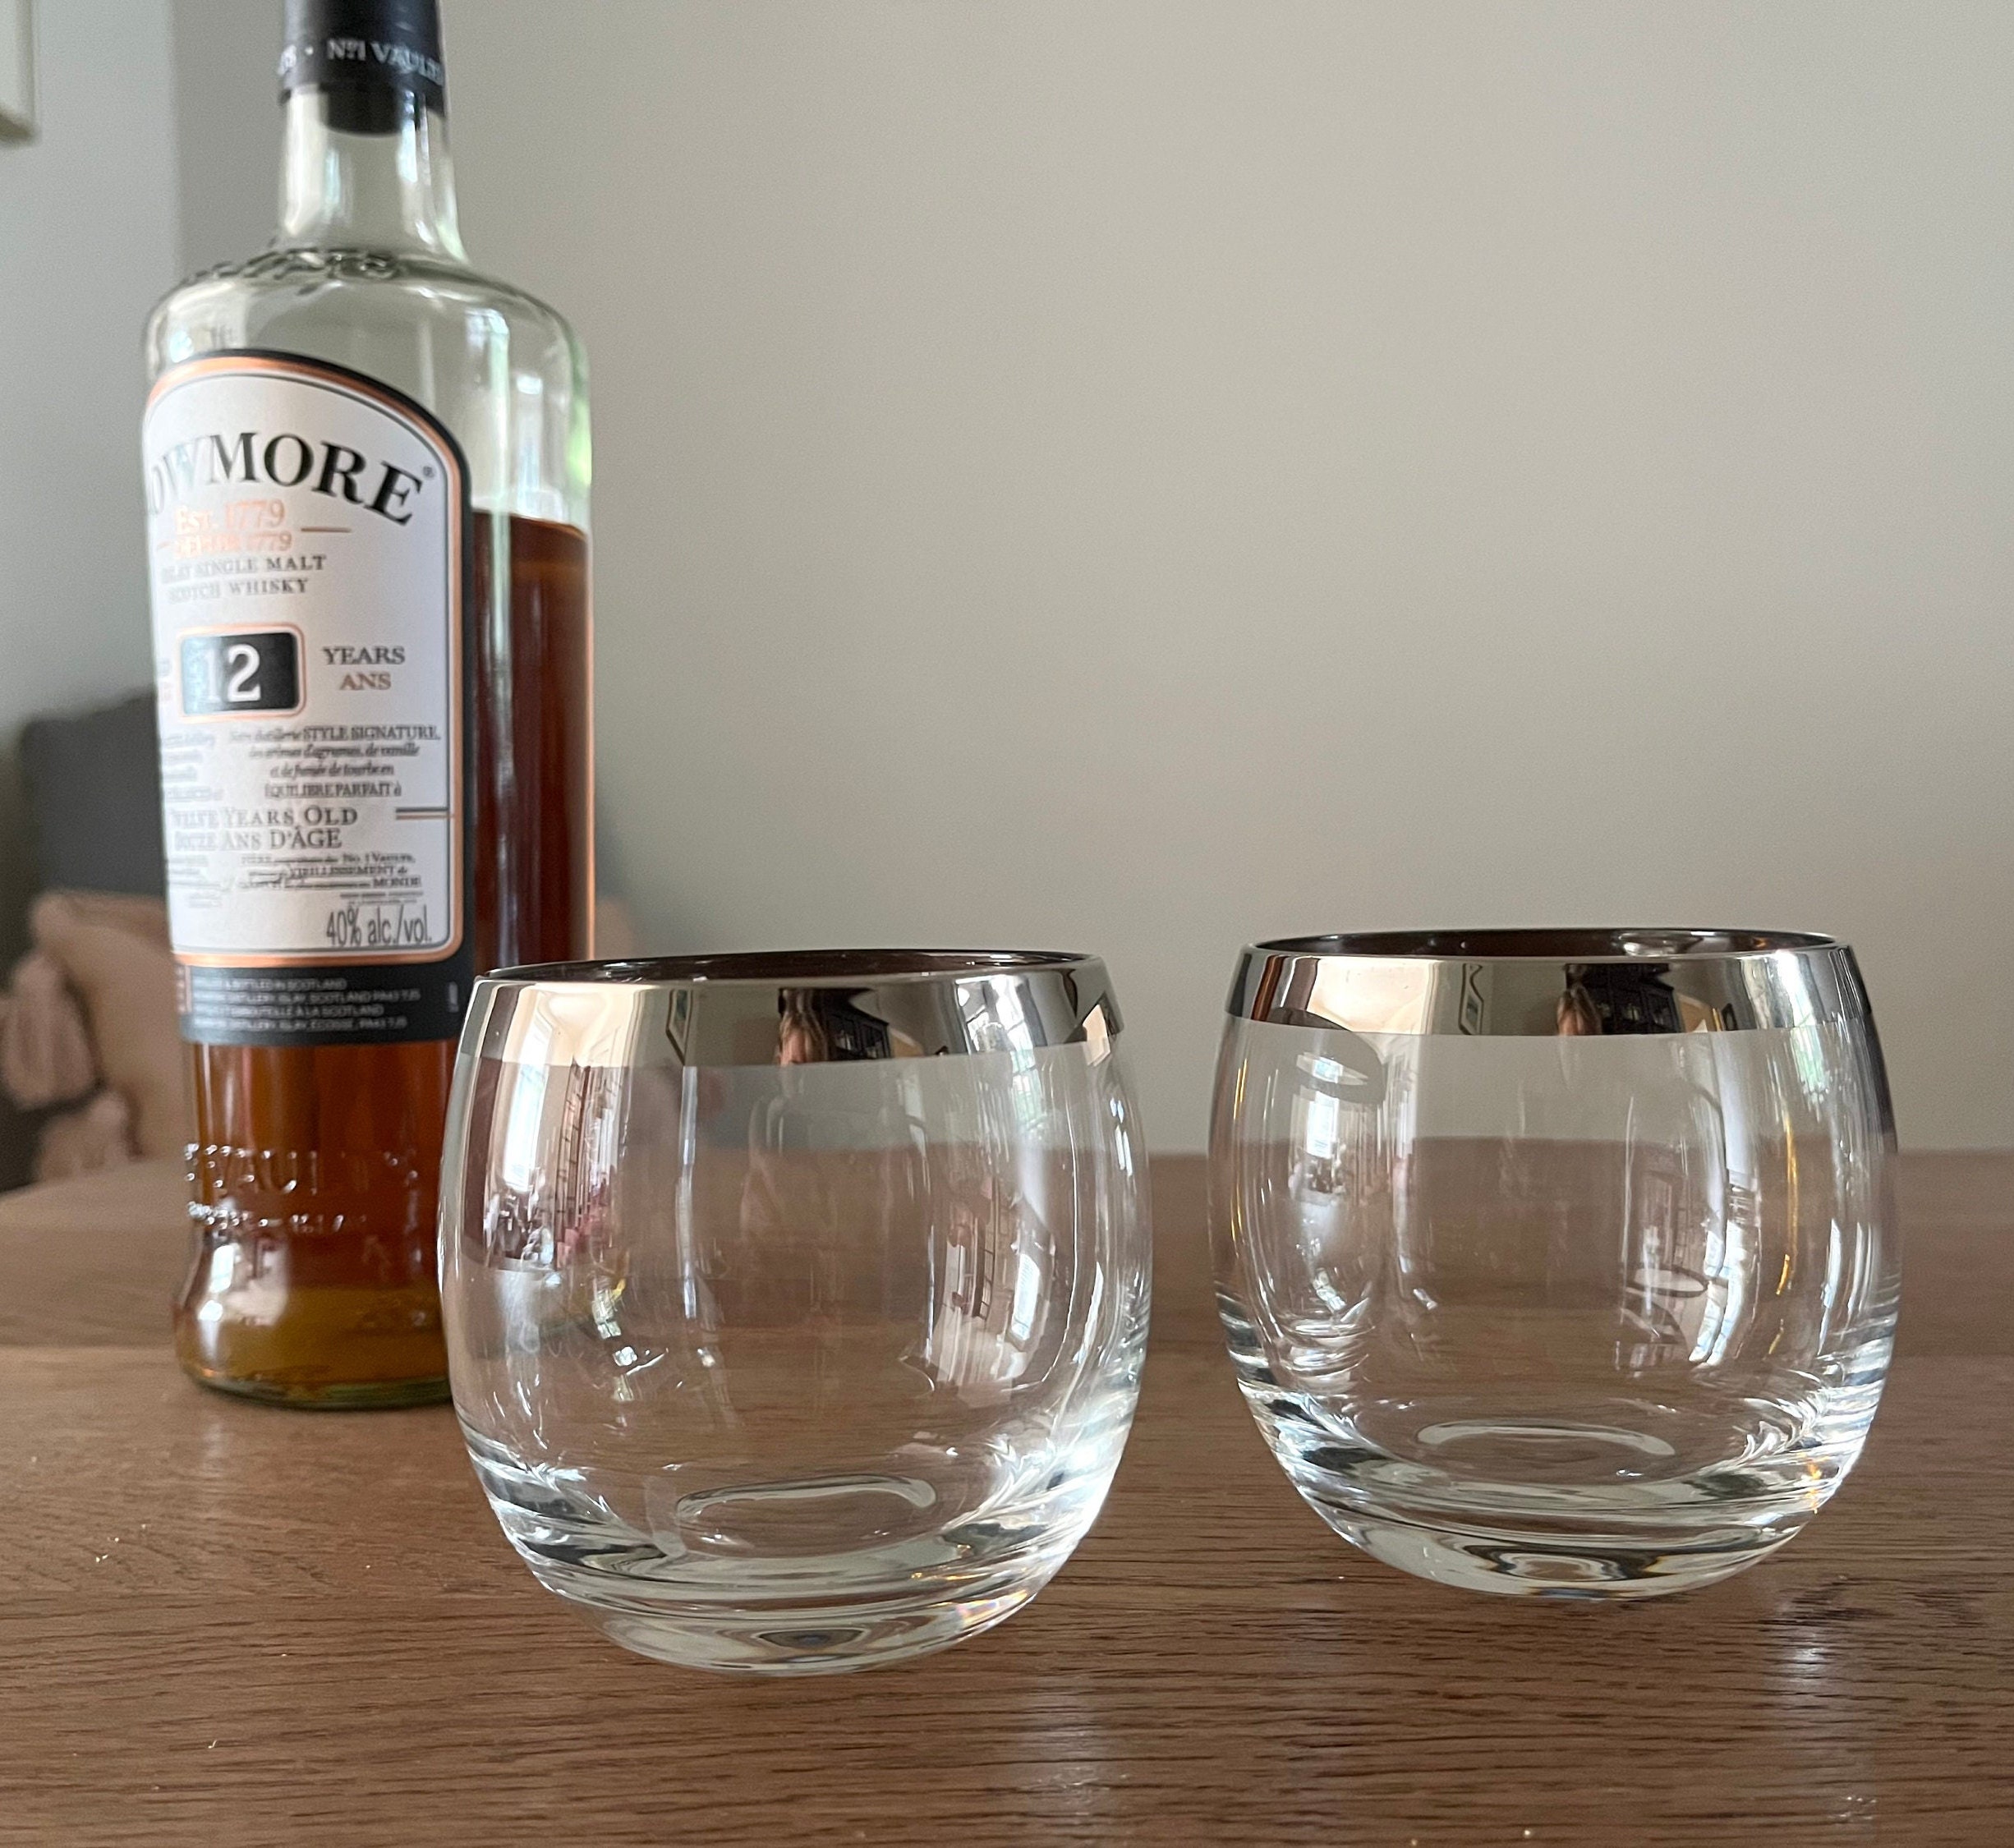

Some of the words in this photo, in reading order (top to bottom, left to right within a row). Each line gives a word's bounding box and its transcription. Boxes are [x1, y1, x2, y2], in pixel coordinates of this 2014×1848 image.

[147, 432, 423, 526] OWMORE
[224, 498, 286, 530] 1779
[266, 554, 328, 572] MALT
[228, 577, 309, 596] WHISKY
[323, 646, 406, 666] YEARS
[202, 643, 261, 704] 12
[339, 671, 392, 690] ANS
[303, 725, 347, 741] STYLE
[335, 782, 390, 798] PARFAIT
[220, 806, 295, 828] YEARS
[304, 804, 358, 825] OLD
[219, 830, 263, 851] ANS
[269, 824, 343, 849] D'ÂGE
[326, 906, 362, 947] 40%
[368, 903, 433, 945] alc./vol.
